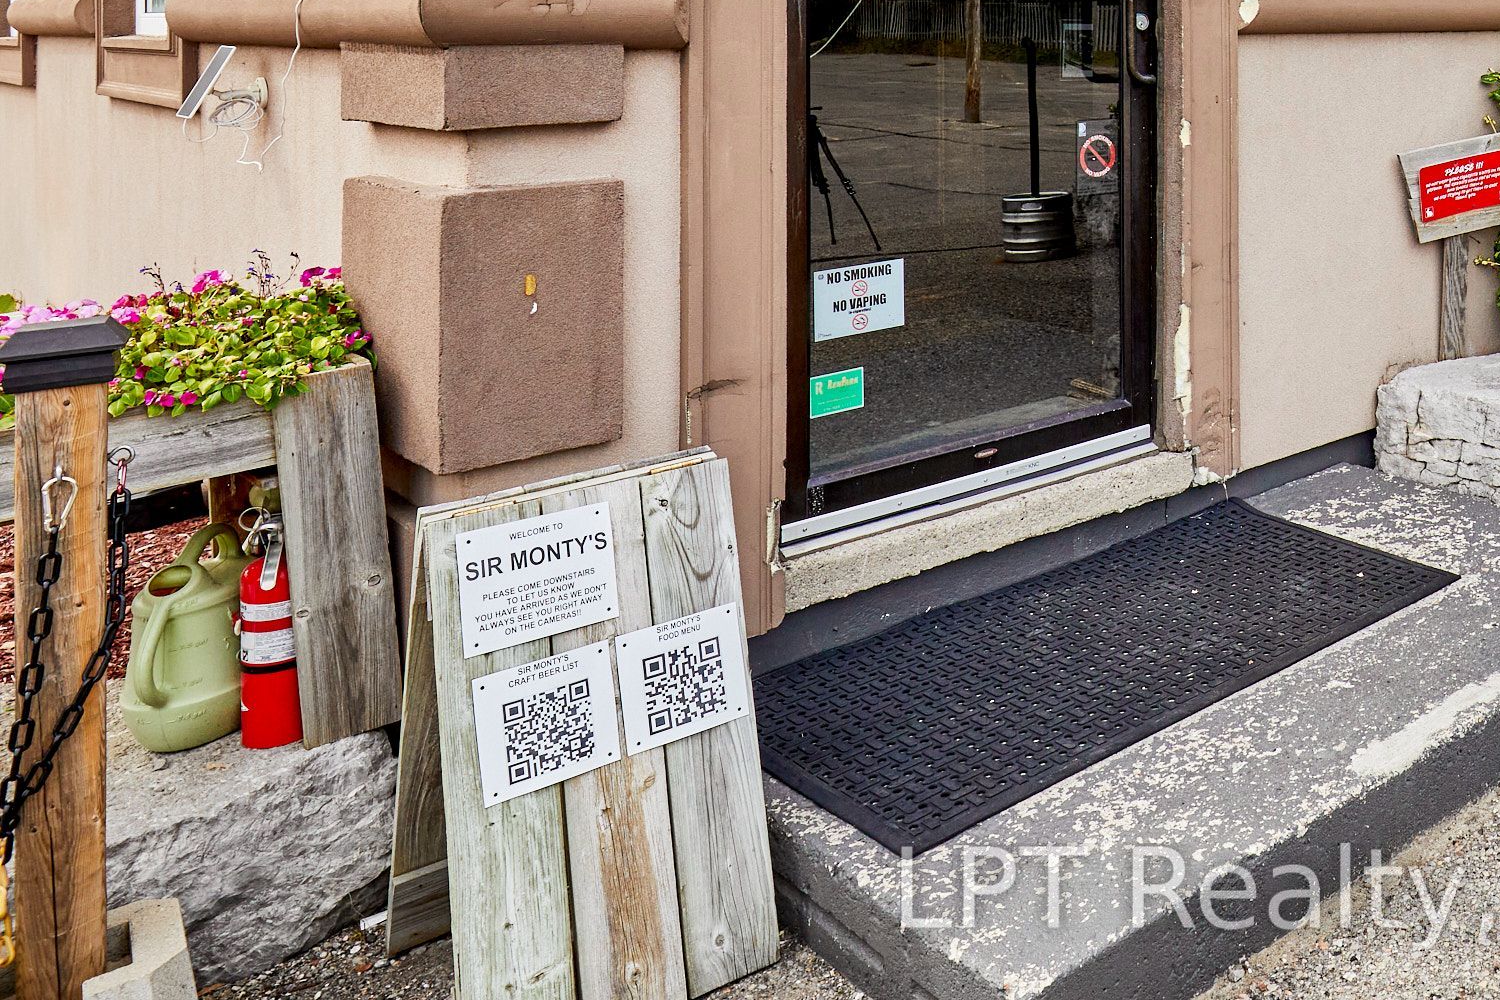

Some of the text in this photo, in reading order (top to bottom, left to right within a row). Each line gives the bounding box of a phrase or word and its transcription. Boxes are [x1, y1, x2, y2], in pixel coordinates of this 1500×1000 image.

[827, 264, 892, 284] NO SMOKING
[833, 293, 886, 313] NO VAPING
[509, 522, 563, 541] WELCOME TO
[465, 532, 607, 581] SIR MONTY'S
[482, 568, 595, 602] PLEASE COME DOWNSTAIRS
[507, 582, 575, 606] TO LET US KNOW
[474, 583, 607, 624] YOU HAVE ARRIVED AS WE DON'T
[479, 593, 603, 632] ALWAYS SEE YOU RIGHT AWAY
[504, 609, 582, 636] ON THE CAMERAS!!
[656, 614, 701, 634] SIR MONTY'S
[658, 624, 701, 642] FOOD MENU
[508, 660, 579, 688] CRAFT BEER LIST
[517, 654, 569, 675] SIR MONTY'S
